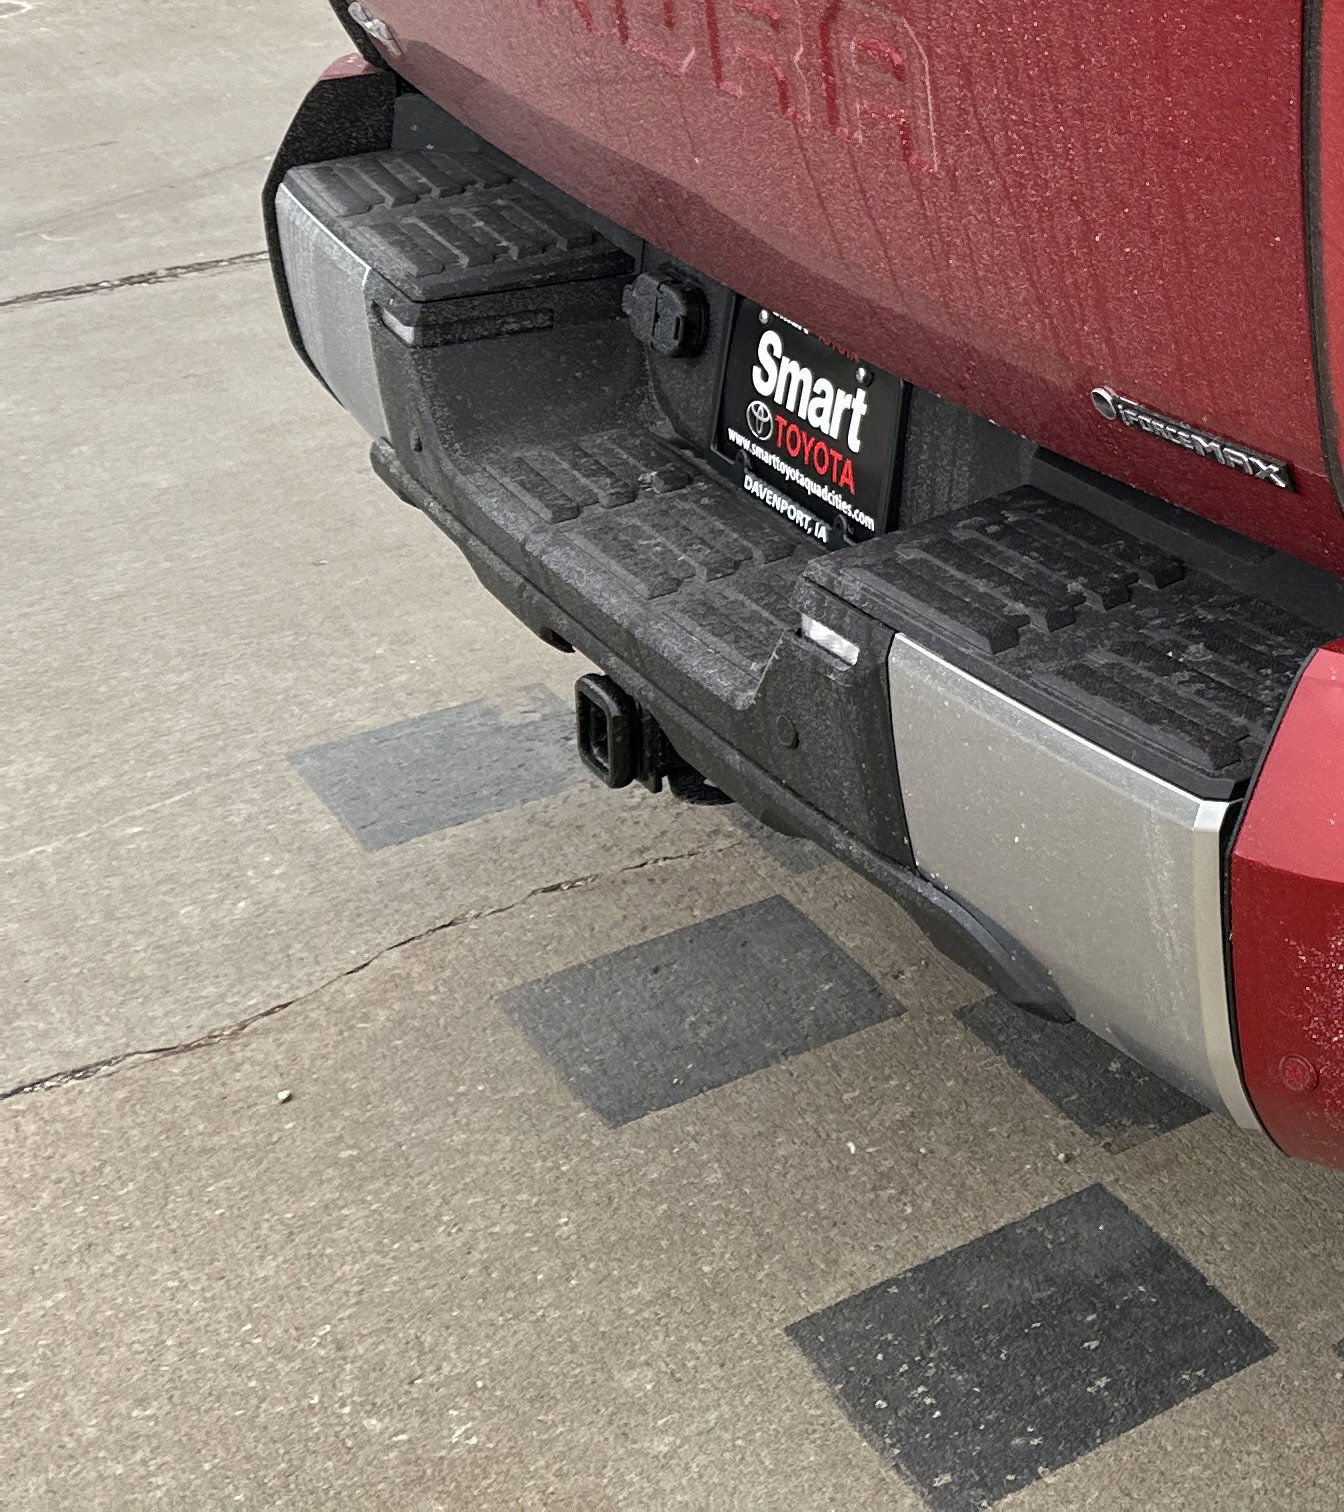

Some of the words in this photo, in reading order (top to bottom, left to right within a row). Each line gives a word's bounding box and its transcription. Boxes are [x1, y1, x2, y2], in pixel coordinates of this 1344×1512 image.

[752, 329, 868, 453] Smart
[728, 427, 875, 532] www.smarttoyotaquadcities.com
[775, 414, 856, 495] TOYOTA
[743, 474, 813, 535] DAVENPORT,
[813, 521, 828, 544] IA
